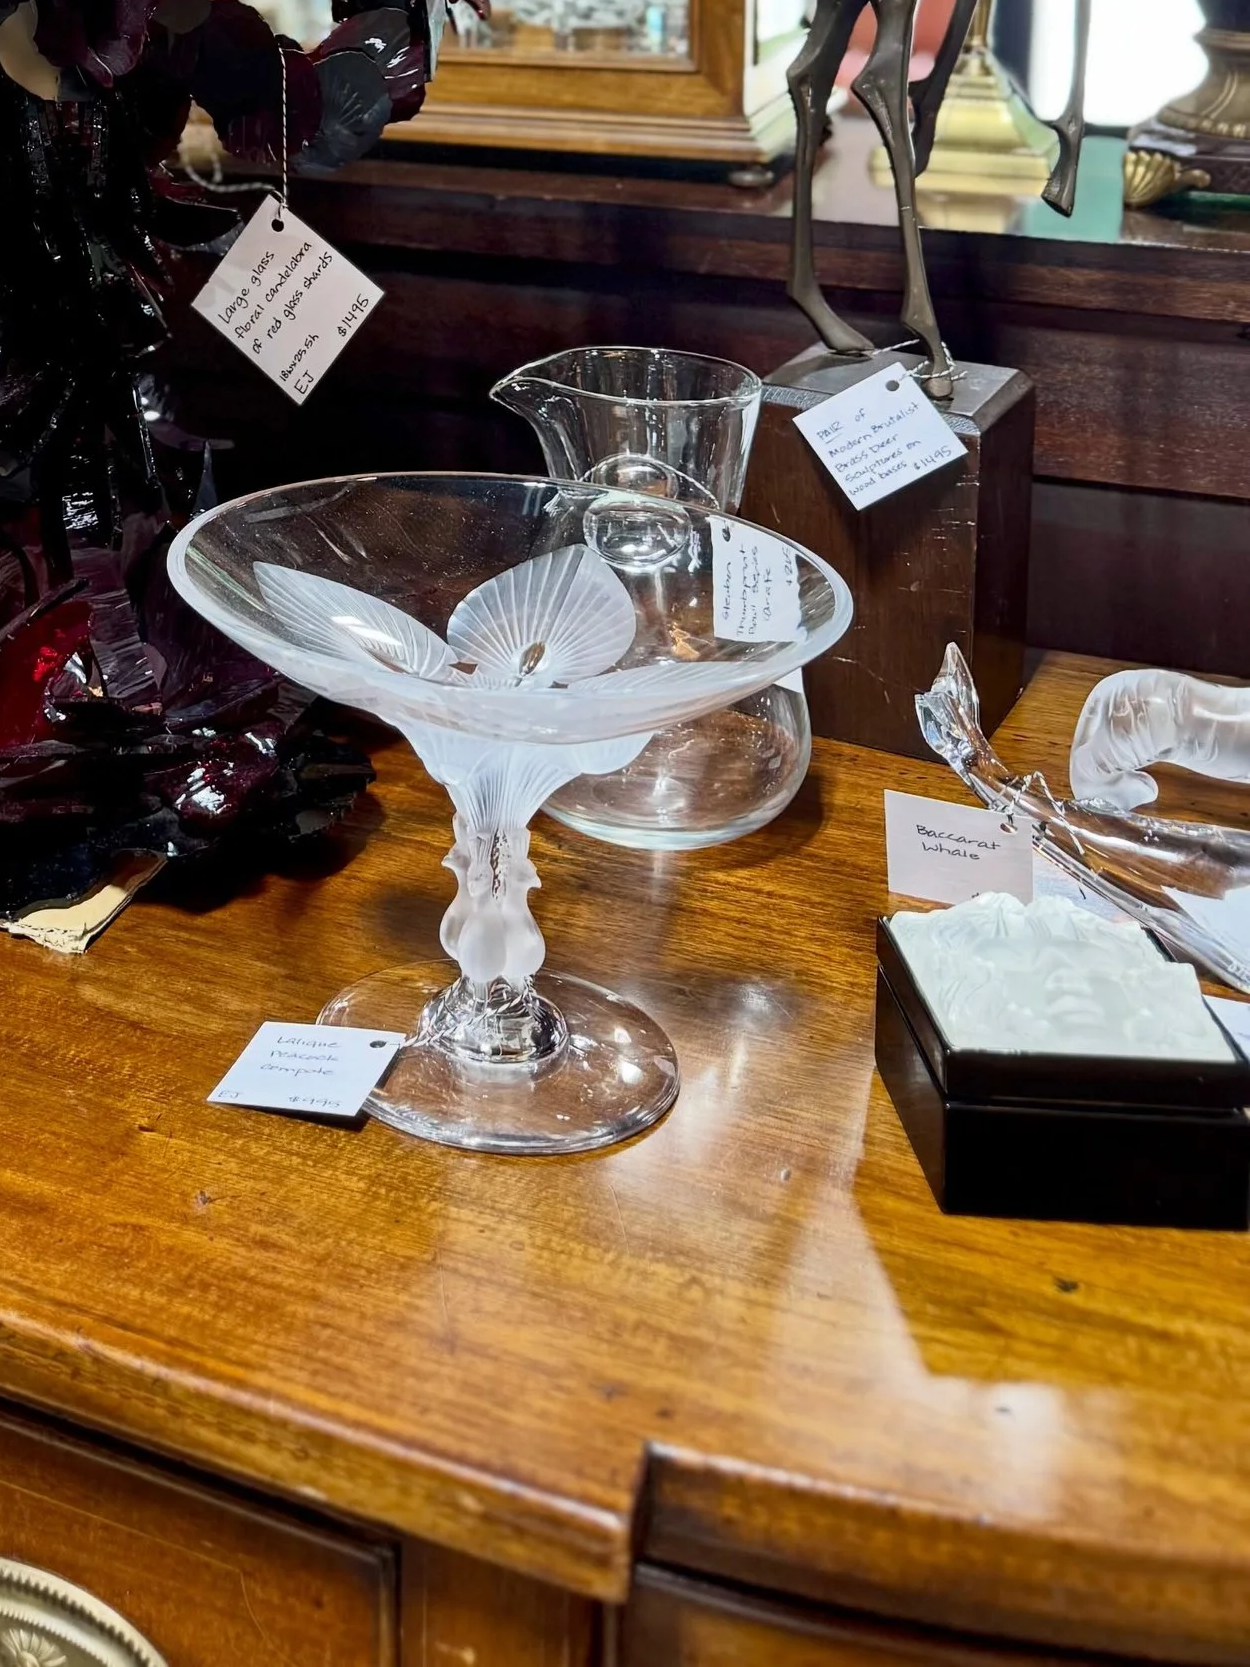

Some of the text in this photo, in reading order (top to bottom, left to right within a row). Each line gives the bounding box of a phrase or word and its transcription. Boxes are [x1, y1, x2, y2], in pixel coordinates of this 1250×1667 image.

[218, 251, 274, 324] Large glass
[234, 242, 312, 339] floral candelabra
[252, 251, 333, 354] of red glass shards
[337, 293, 369, 337] $1495
[293, 369, 314, 395] EJ
[816, 421, 843, 440] PAIR
[828, 402, 919, 458] Modern Brutalist
[835, 433, 898, 473] Brass Deer
[906, 439, 921, 450] on
[913, 445, 952, 470] $1495
[878, 460, 907, 479] bases
[916, 824, 1001, 850] Baccarat
[922, 841, 980, 860] Whale
